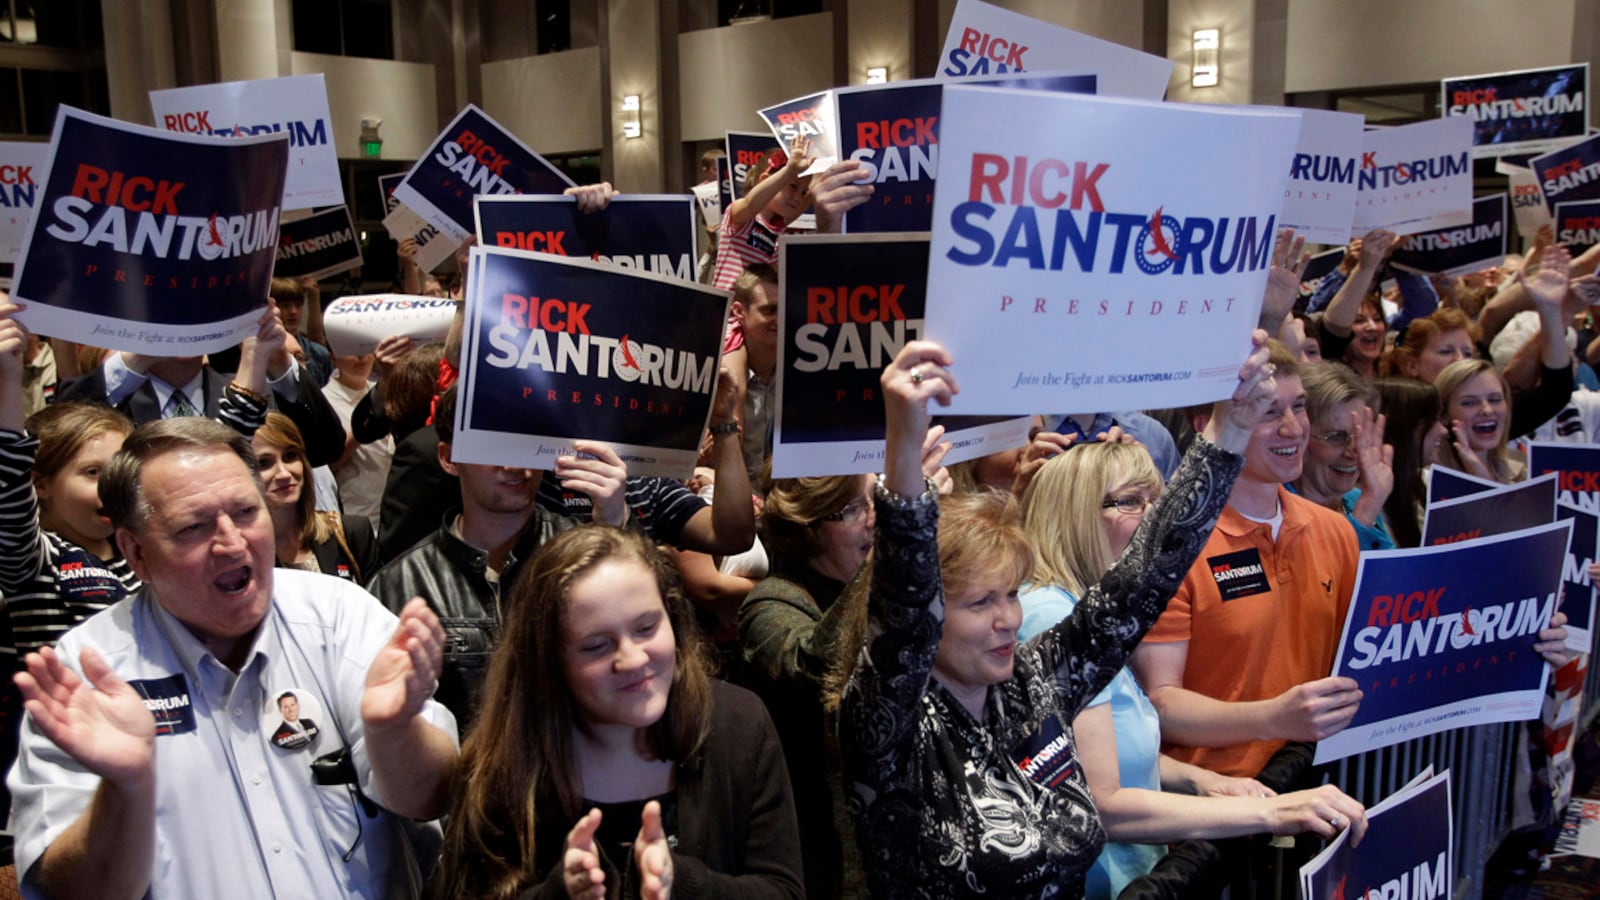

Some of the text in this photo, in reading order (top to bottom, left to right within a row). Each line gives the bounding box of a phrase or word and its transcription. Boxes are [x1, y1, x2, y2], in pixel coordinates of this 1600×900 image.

[959, 27, 1029, 70] RICK
[1448, 91, 1583, 121] SANTORUM
[1453, 88, 1497, 106] RICK
[165, 110, 213, 133] RICK
[857, 117, 938, 149] RICK
[456, 129, 511, 176] RICK
[1291, 153, 1355, 184] RUM
[72, 163, 187, 216] RICK
[967, 153, 1111, 212] RICK
[1544, 162, 1600, 197] SANT
[46, 195, 280, 261] SANTORUM
[496, 231, 567, 257] RICK
[946, 201, 1276, 276] SANTORUM
[502, 294, 592, 336] RICK
[806, 284, 907, 325] RICK
[1000, 296, 1236, 316] PRESIDENT
[92, 324, 115, 337] Join
[117, 329, 136, 340] the
[485, 325, 715, 395] SANTORUM
[1012, 372, 1039, 389] Join
[1042, 371, 1061, 385] the
[1064, 372, 1091, 389] Fight
[1094, 374, 1104, 385] at
[1107, 371, 1192, 385] RICKSANTORUM.COM
[523, 386, 685, 417] PRESIDENT
[851, 450, 875, 463] Join
[1543, 469, 1600, 492] ICK
[1214, 563, 1263, 582] SANTORUM
[1367, 587, 1446, 627] RICK
[1347, 593, 1556, 670] SANTORUM
[1371, 651, 1516, 691] PRESIDENT
[142, 694, 189, 711] ORUM
